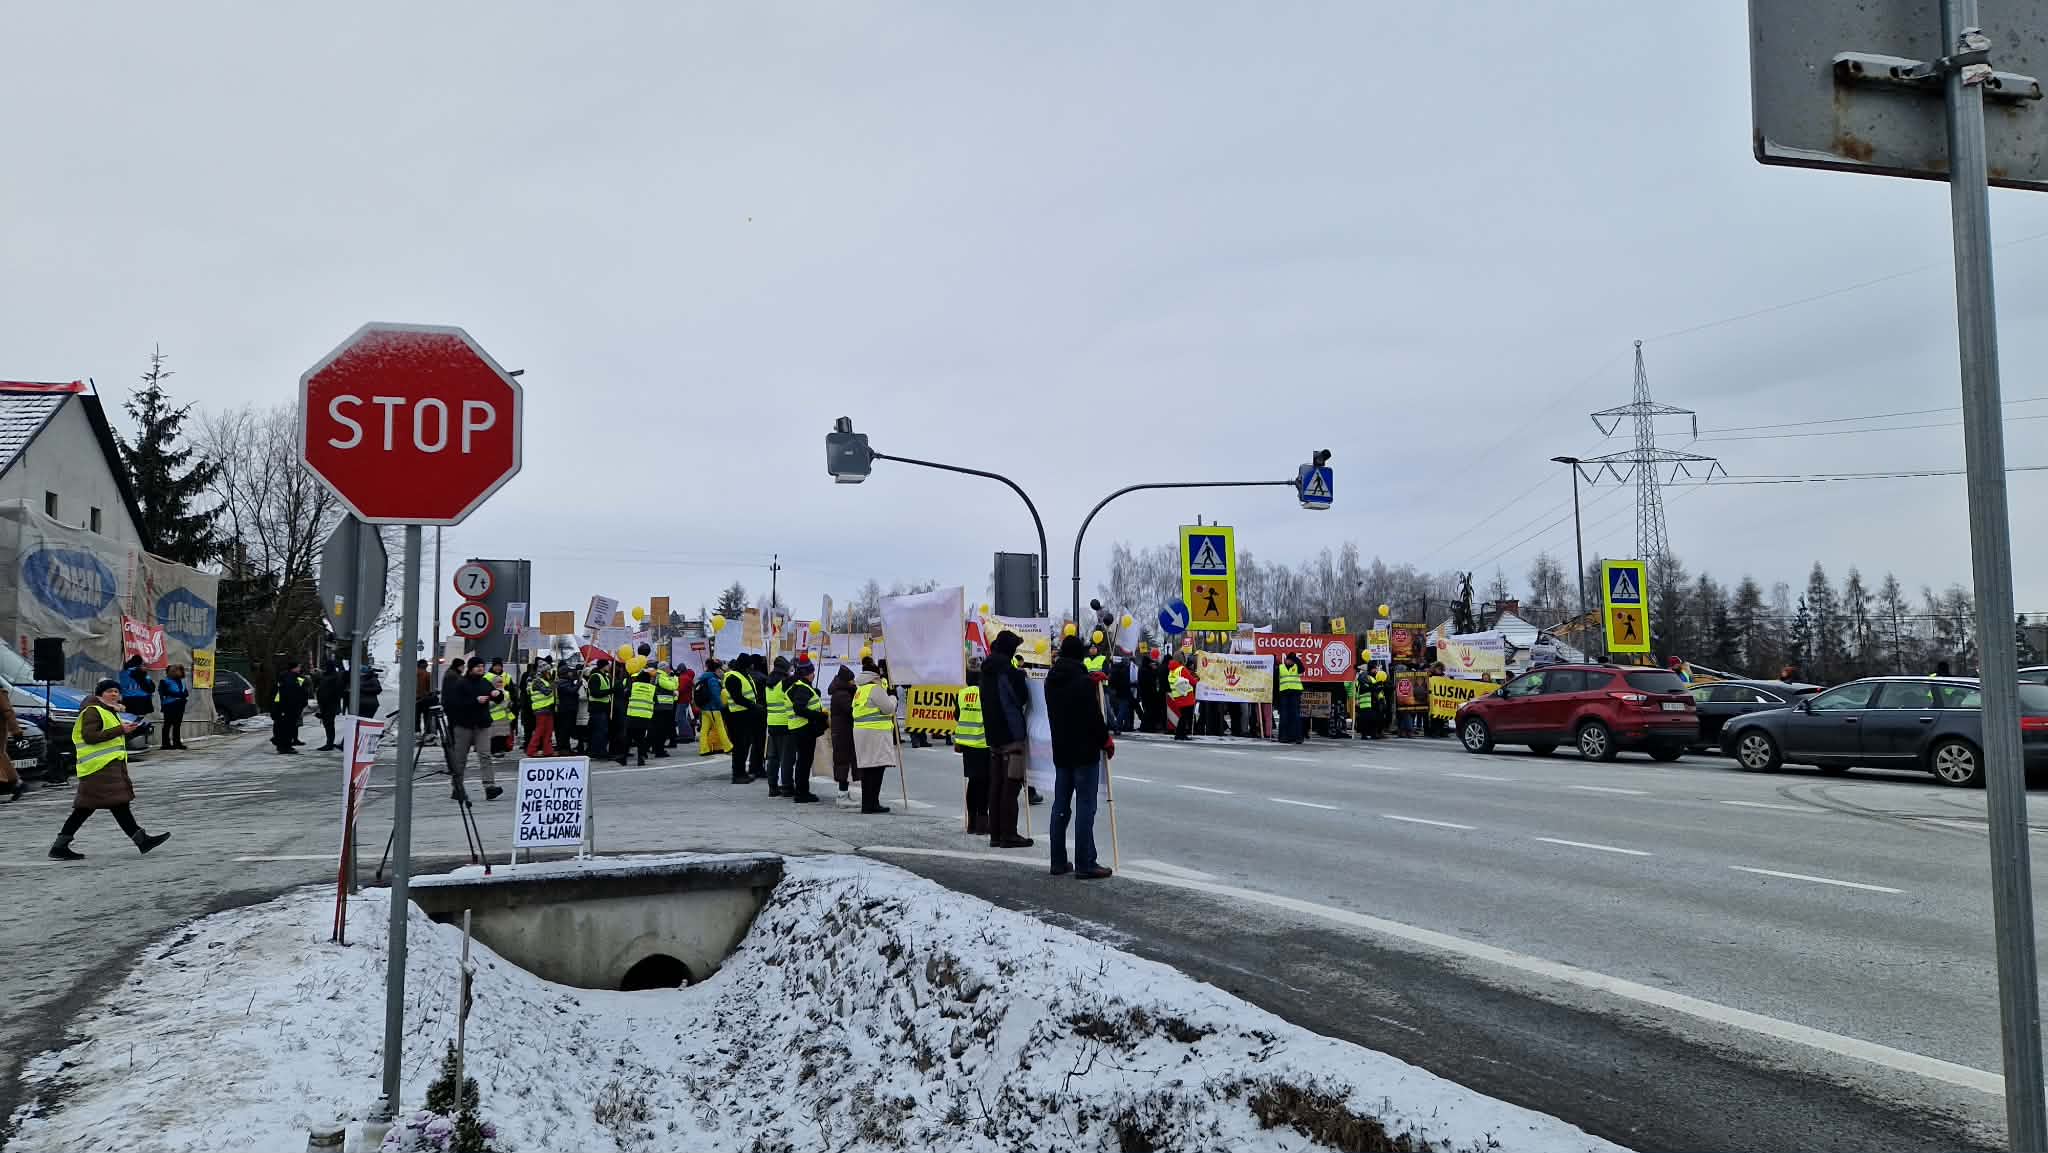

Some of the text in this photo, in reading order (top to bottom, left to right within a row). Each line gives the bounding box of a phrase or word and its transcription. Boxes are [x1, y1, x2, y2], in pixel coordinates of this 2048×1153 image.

[328, 394, 497, 454] STOP
[459, 611, 487, 629] 50
[1257, 636, 1323, 648] GŁOGOCZÓW
[1305, 653, 1320, 665] S7
[1327, 648, 1346, 657] STOP
[1330, 658, 1344, 667] S7
[1433, 684, 1476, 700] LUSINA
[525, 787, 583, 800] POLITYCY
[521, 800, 542, 813] NIE
[521, 812, 580, 825] Z LUDZI
